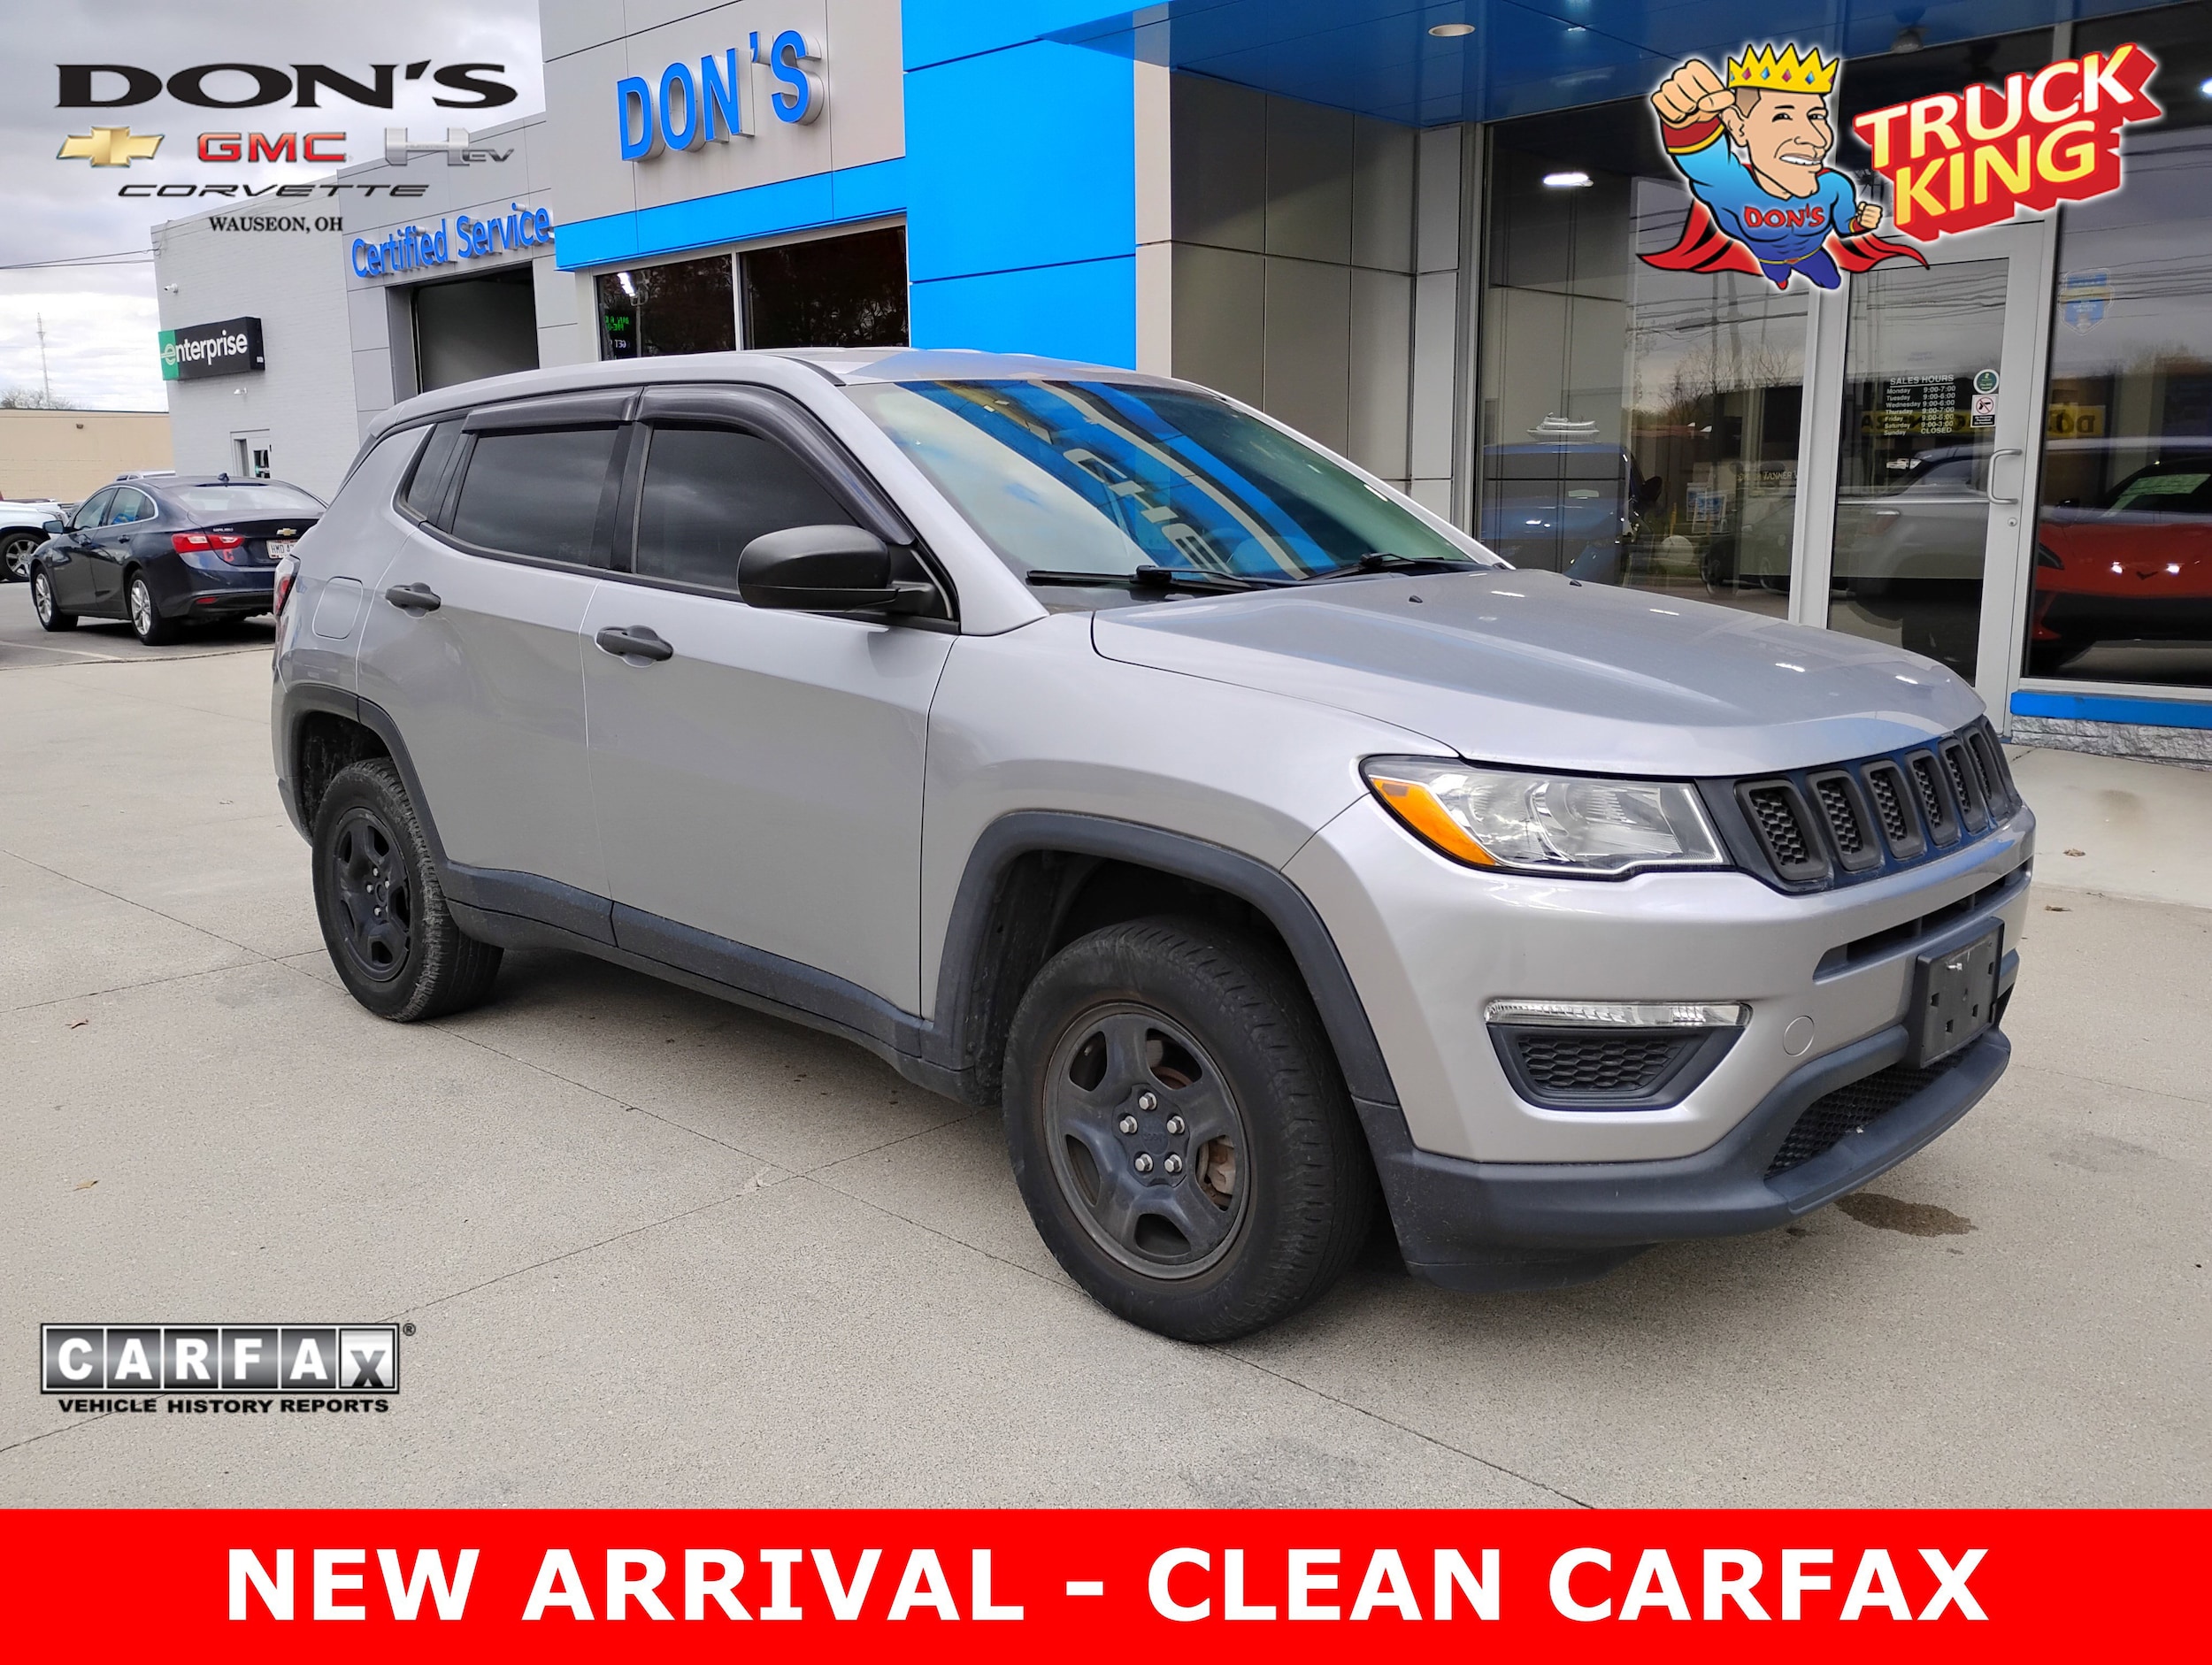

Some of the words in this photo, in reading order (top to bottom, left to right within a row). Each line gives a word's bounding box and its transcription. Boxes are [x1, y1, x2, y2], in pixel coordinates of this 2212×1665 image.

[617, 30, 814, 162] DON'S
[351, 218, 449, 278] Certified
[456, 202, 550, 258] Service
[160, 329, 248, 366] enterprise
[1890, 376, 1919, 386] SALES
[1921, 374, 1955, 383] HOURS
